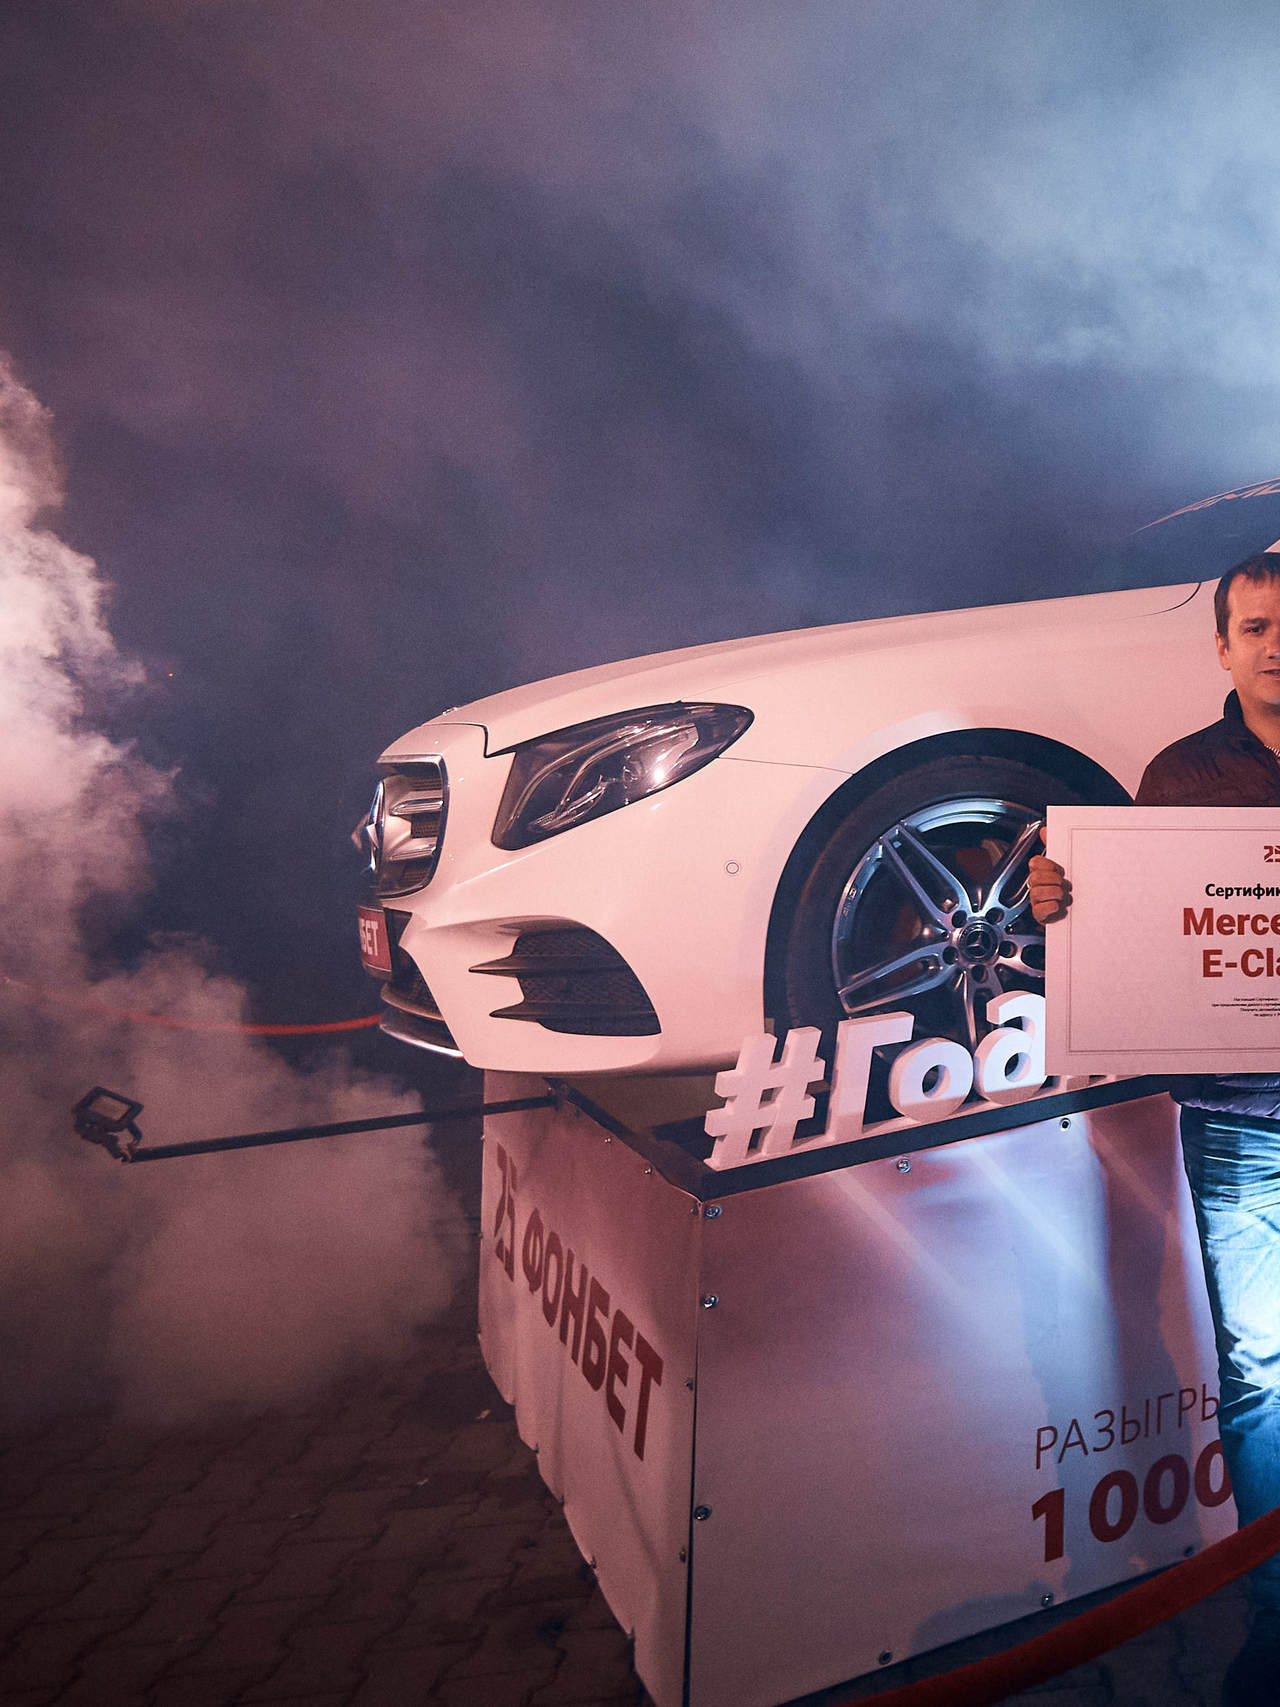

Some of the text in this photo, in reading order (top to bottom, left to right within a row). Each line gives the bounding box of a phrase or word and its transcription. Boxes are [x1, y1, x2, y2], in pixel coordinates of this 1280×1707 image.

[703, 990, 1047, 1172] #Год
[522, 1207, 663, 1462] ФОНБЕТ
[1032, 1488, 1065, 1563] 1
